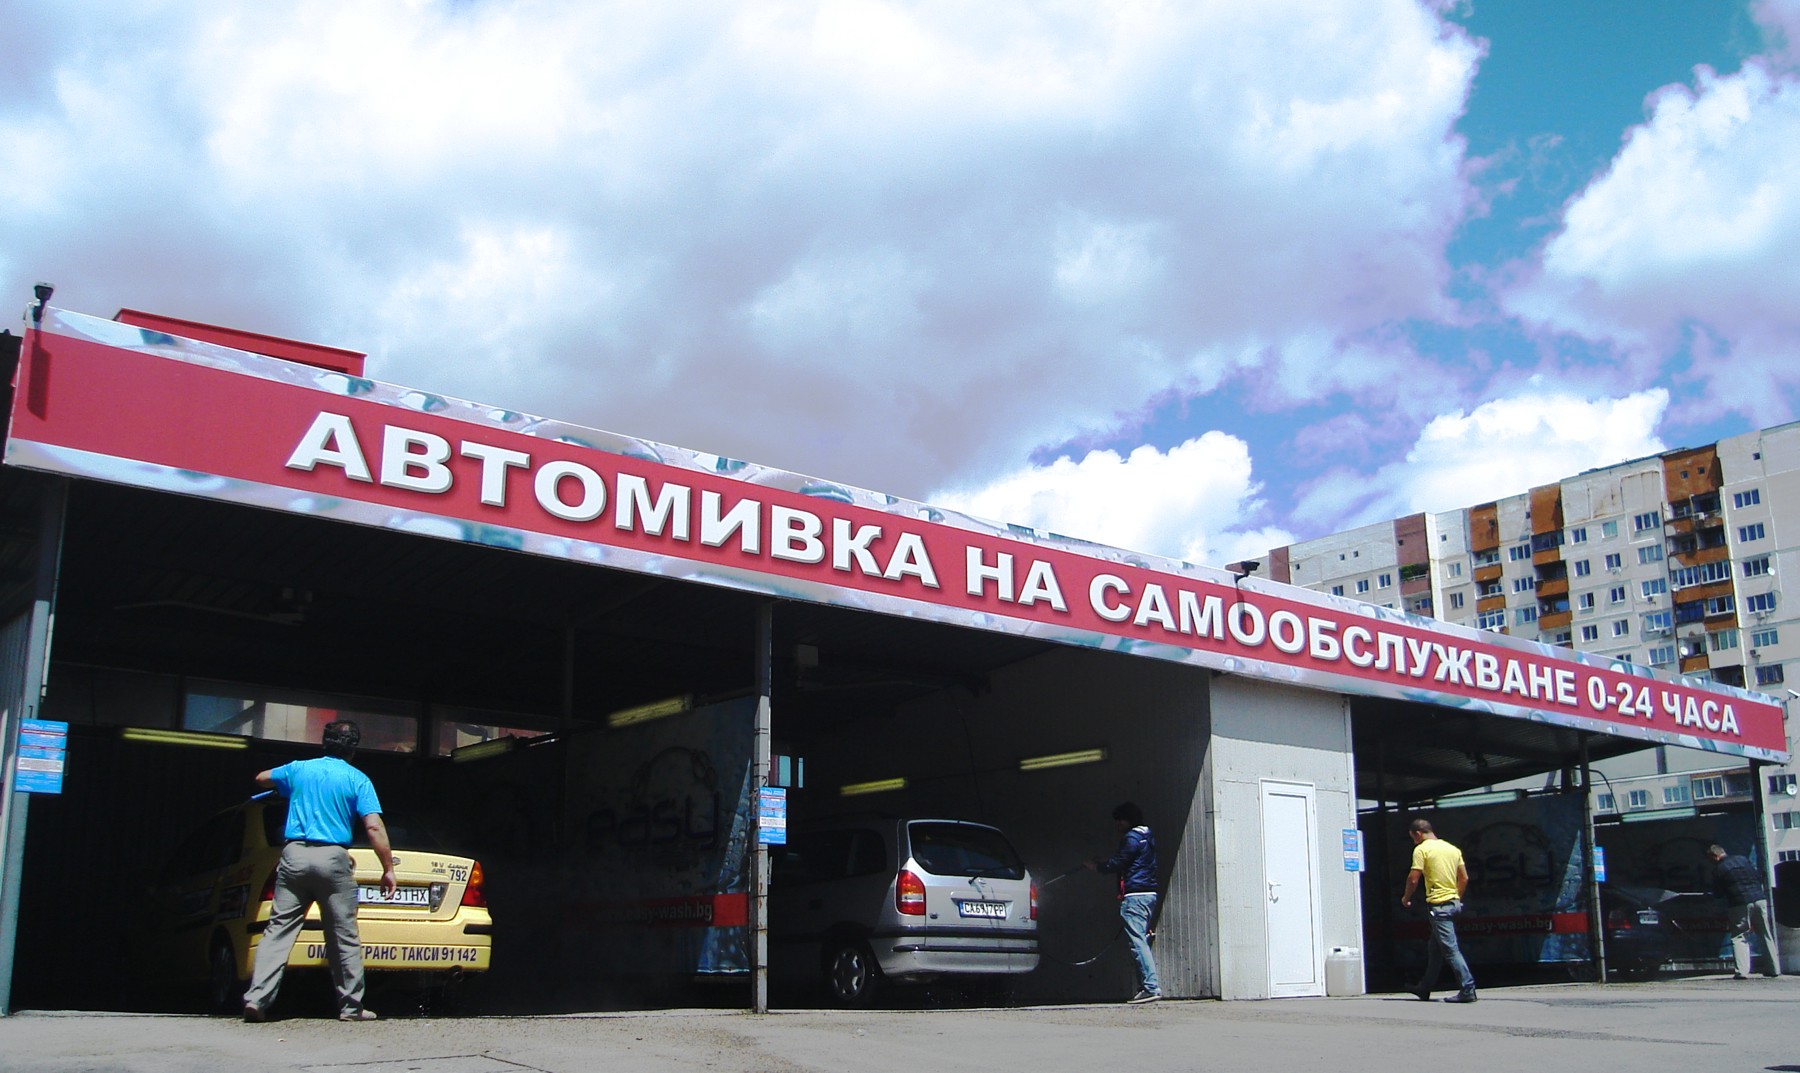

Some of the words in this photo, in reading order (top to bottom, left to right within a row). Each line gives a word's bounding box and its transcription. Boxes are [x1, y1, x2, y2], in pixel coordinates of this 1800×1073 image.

[285, 411, 940, 588] АВТОМИВКА
[966, 545, 1069, 613] НА
[1088, 573, 1578, 706] САМООБСЛУЖВАНЕ
[1586, 675, 1653, 720] 0-24
[1661, 690, 1741, 736] ЧАСА
[450, 869, 467, 882] 792
[1467, 849, 1553, 889] asy
[402, 946, 439, 961] ТАКСИ
[441, 947, 477, 962] 91142
